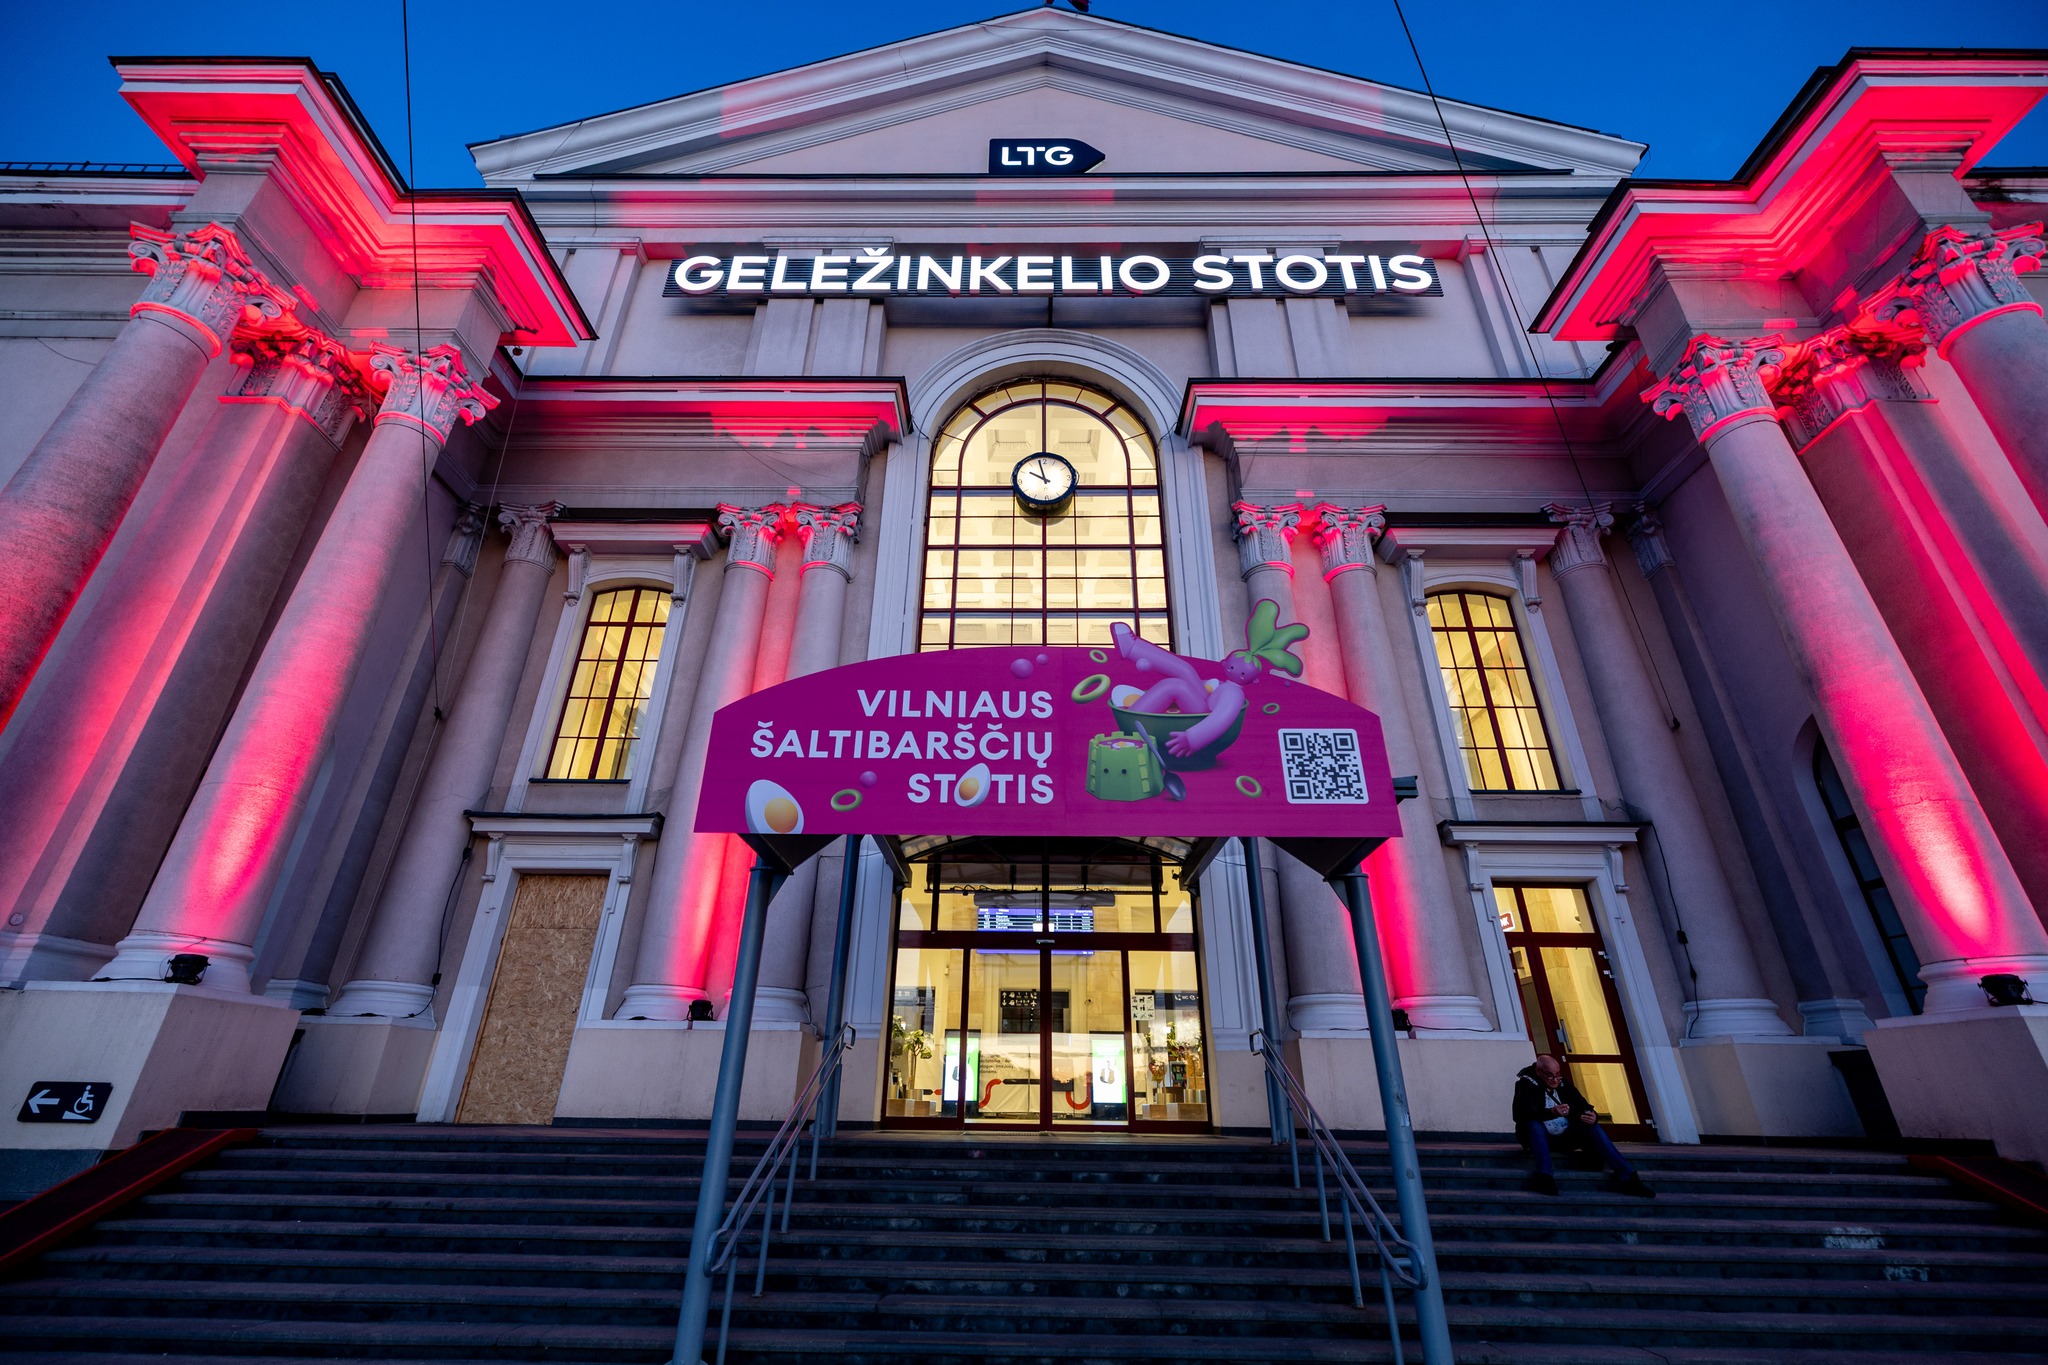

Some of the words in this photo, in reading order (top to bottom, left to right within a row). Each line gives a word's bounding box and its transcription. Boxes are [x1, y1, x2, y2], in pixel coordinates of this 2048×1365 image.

[1001, 146, 1074, 166] LTG
[674, 247, 1171, 291] GELEŽINKELIO
[1191, 253, 1434, 291] STOTIS
[857, 688, 1054, 719] VILNIAUS
[750, 719, 1053, 770] ŠALTIBARŠČIŲ
